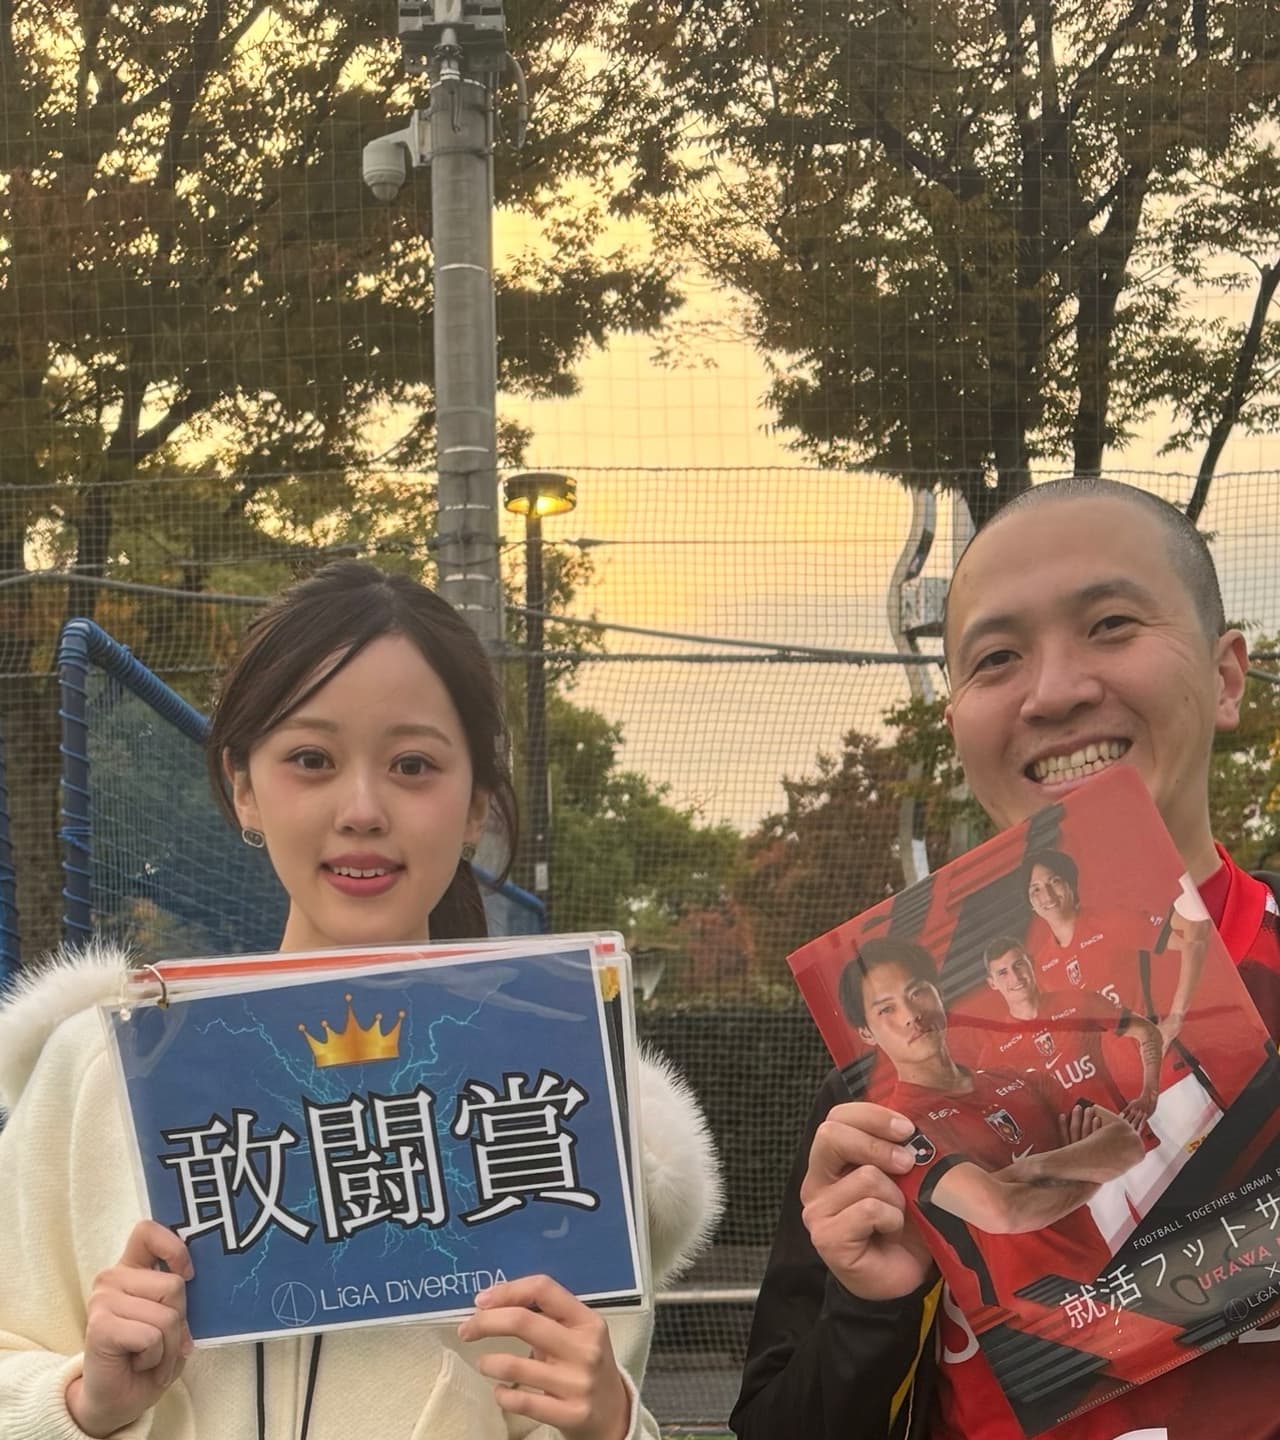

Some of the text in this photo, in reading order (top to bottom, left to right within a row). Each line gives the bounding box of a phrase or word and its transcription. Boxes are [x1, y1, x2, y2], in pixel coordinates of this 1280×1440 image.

[1053, 1055, 1097, 1090] LUS
[162, 1071, 600, 1252] 敢闘賞
[1132, 1220, 1184, 1250] FOOTBALL
[1185, 1191, 1238, 1223] TOGETHER
[1239, 1173, 1273, 1196] URAWA
[1197, 1245, 1273, 1291] URAWA
